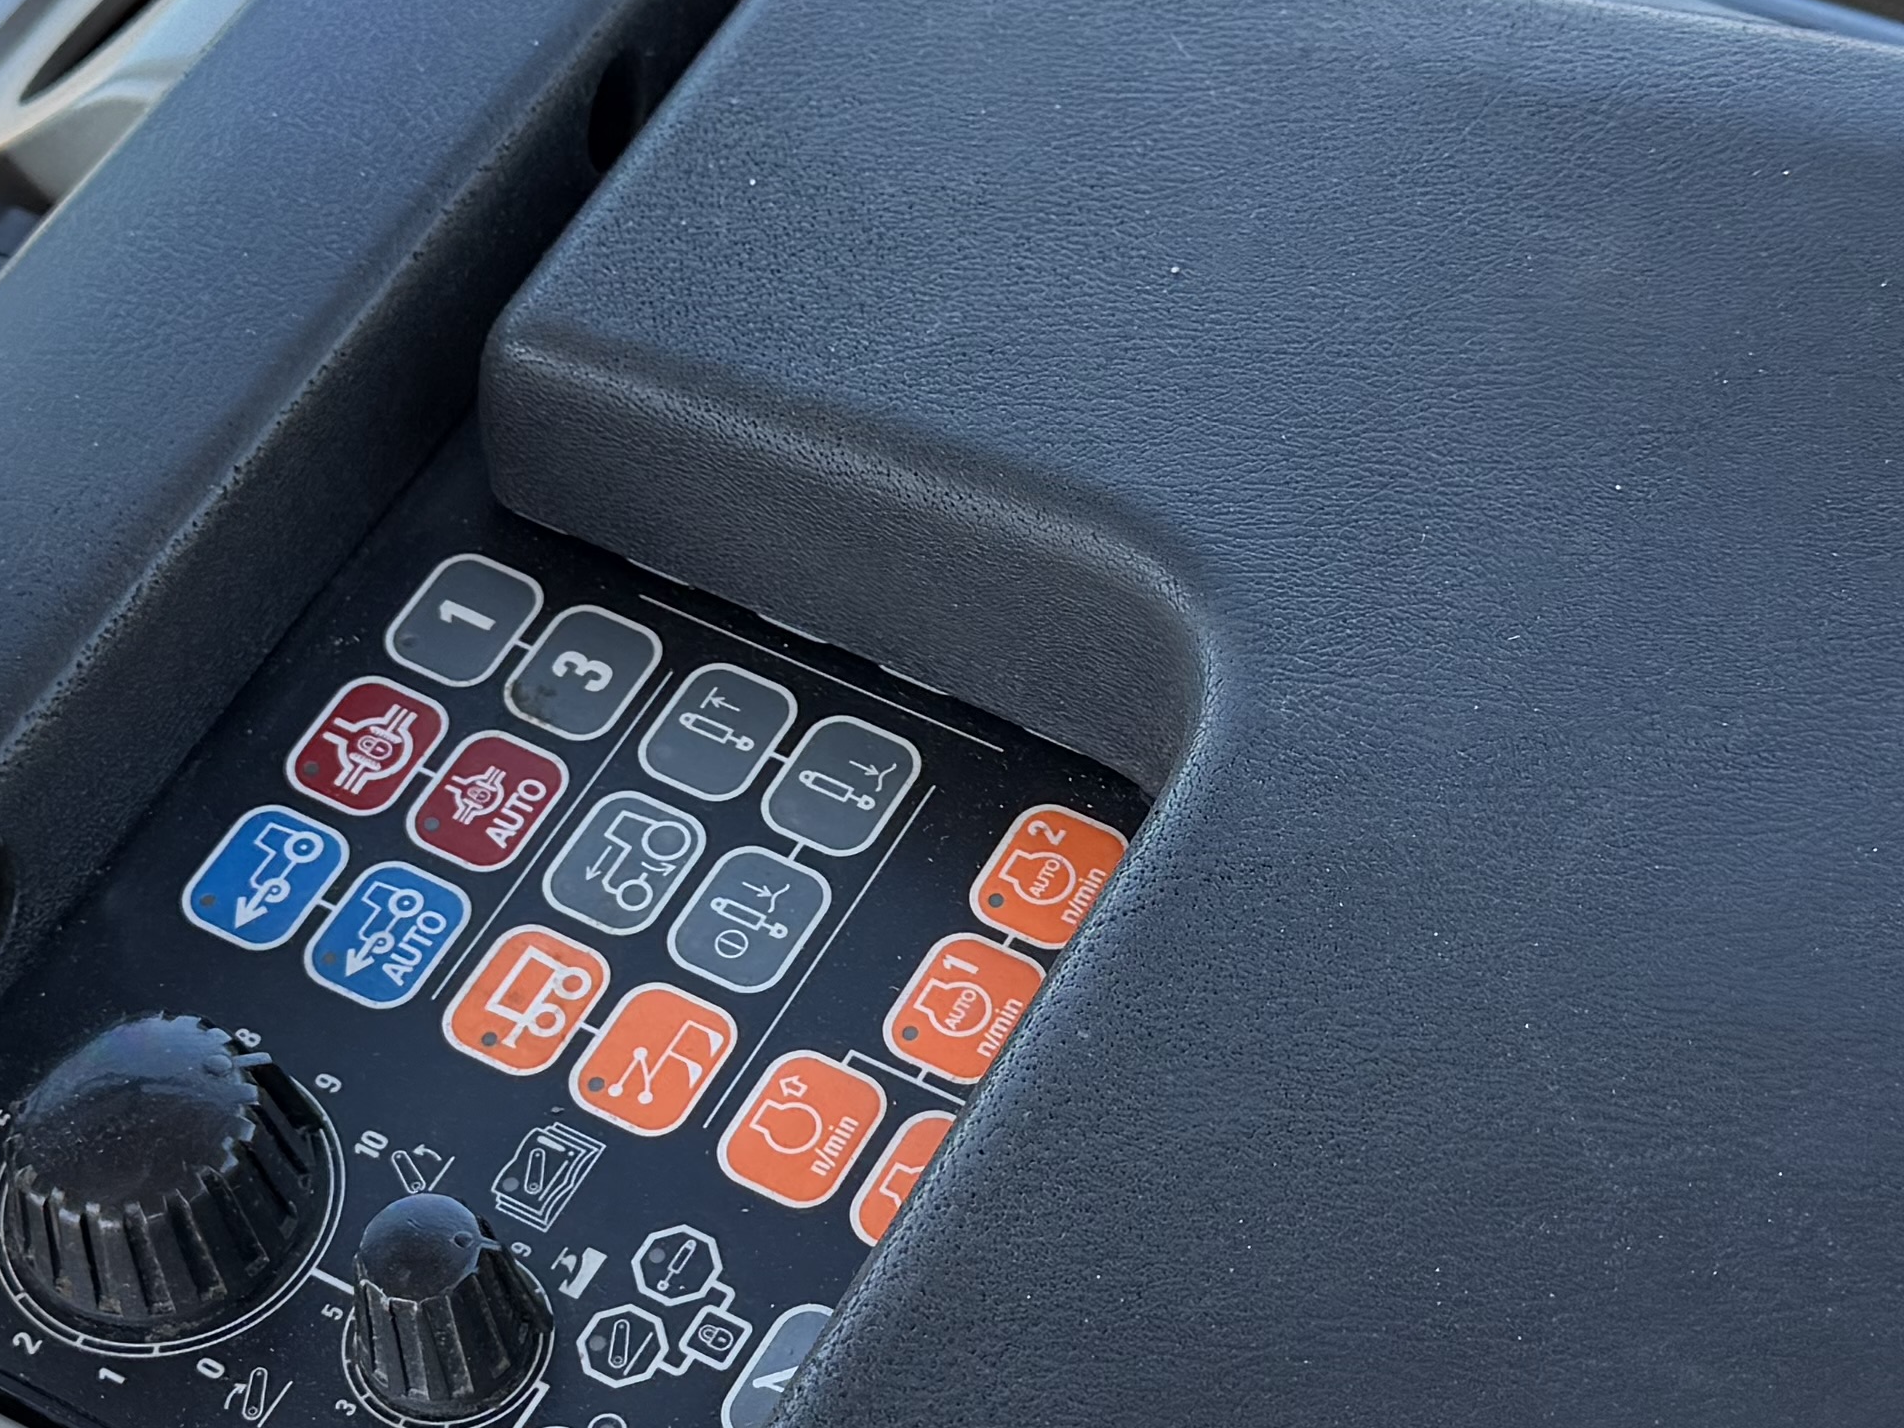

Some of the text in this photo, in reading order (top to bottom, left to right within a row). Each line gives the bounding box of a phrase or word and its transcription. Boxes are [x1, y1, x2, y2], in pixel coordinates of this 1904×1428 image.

[439, 600, 496, 630] 1
[552, 650, 613, 691] 3
[485, 778, 547, 849] AUTO
[1027, 820, 1067, 846] 2
[1029, 859, 1061, 899] AUTO
[1060, 868, 1107, 925] n/min
[381, 909, 447, 987] AUTO
[942, 954, 979, 975] 1
[944, 988, 977, 1030] AUTO
[234, 1028, 262, 1048] 8
[976, 998, 1024, 1058] n/min
[314, 1073, 342, 1093] 9
[354, 1130, 389, 1158] 10
[810, 1116, 859, 1176] n/min
[321, 1303, 344, 1320] 5
[12, 1331, 43, 1354] 2
[98, 1367, 126, 1384] 1
[196, 1357, 225, 1379] 0
[335, 1398, 357, 1416] 3
